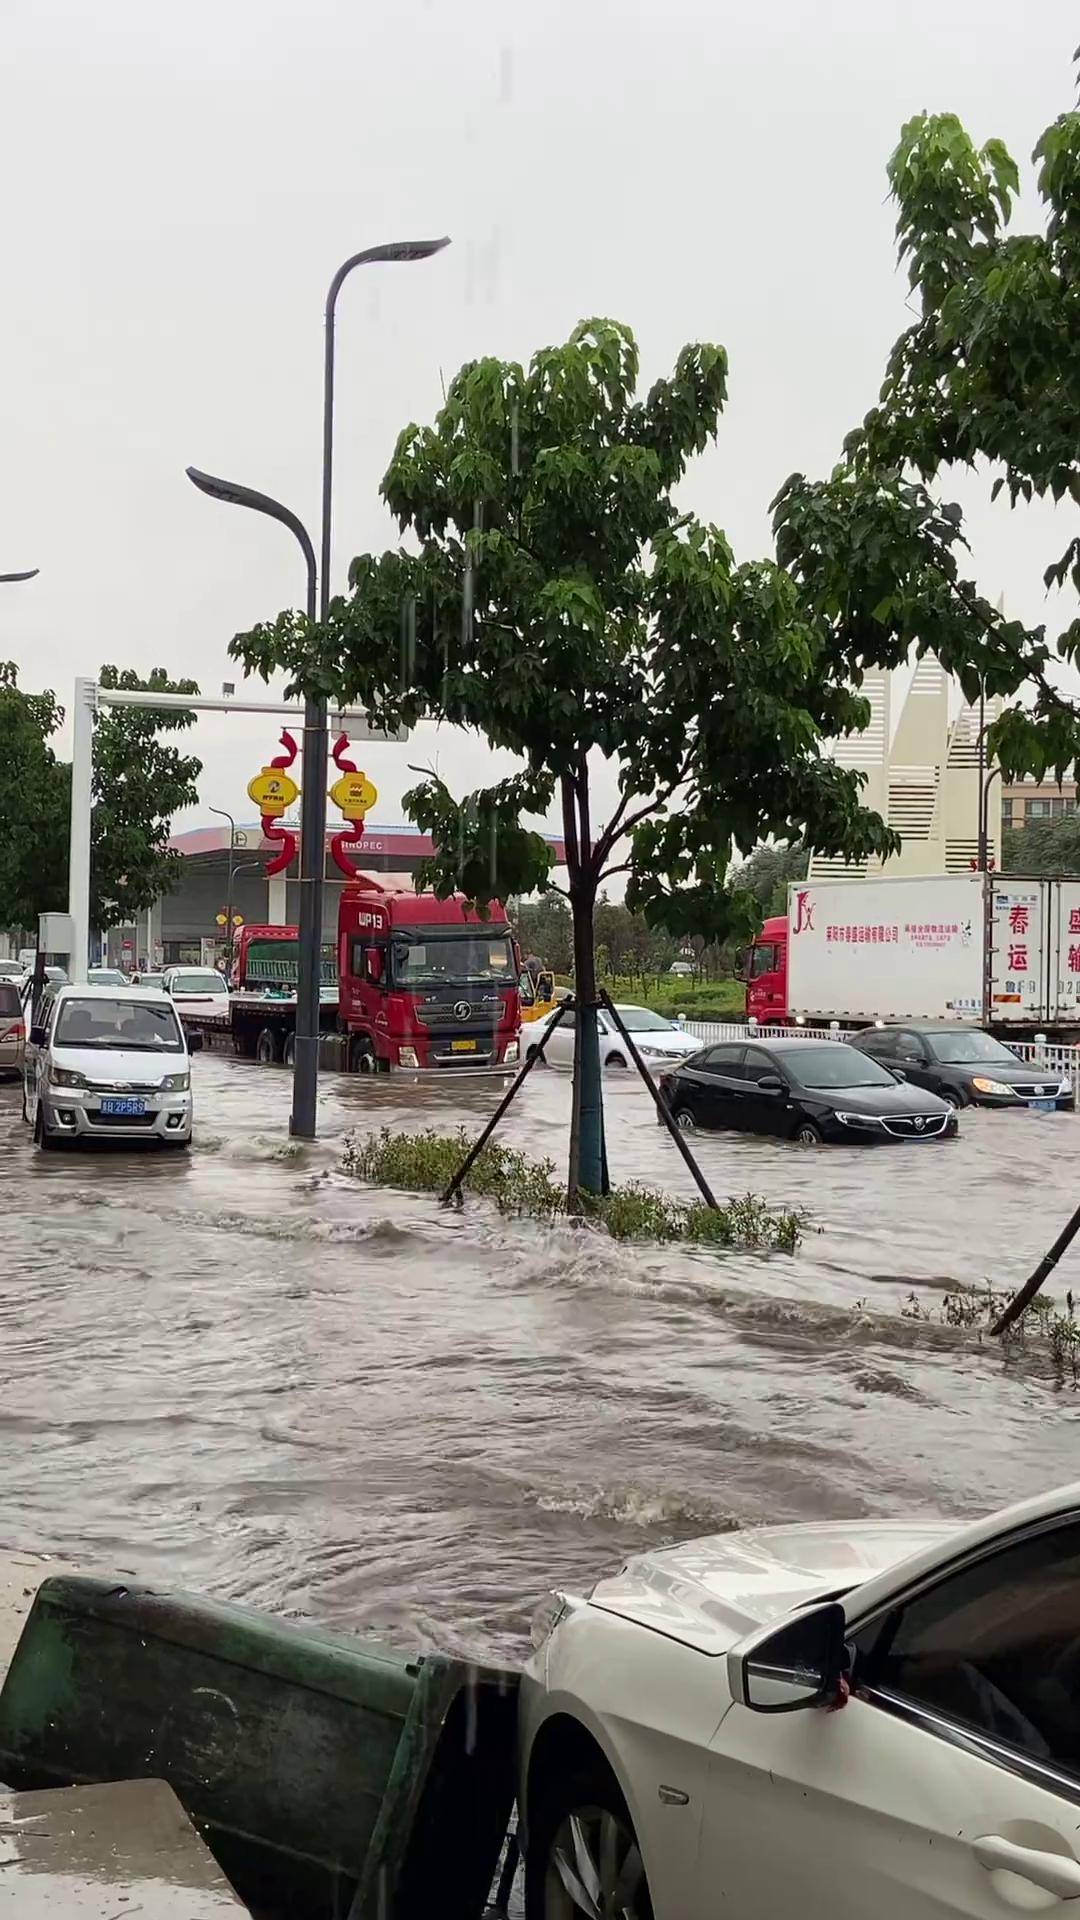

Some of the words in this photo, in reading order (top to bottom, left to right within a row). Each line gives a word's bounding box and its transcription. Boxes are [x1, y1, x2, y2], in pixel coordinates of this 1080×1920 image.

[358, 911, 383, 929] WP13
[1009, 905, 1028, 934] 春
[1008, 944, 1027, 970] 运
